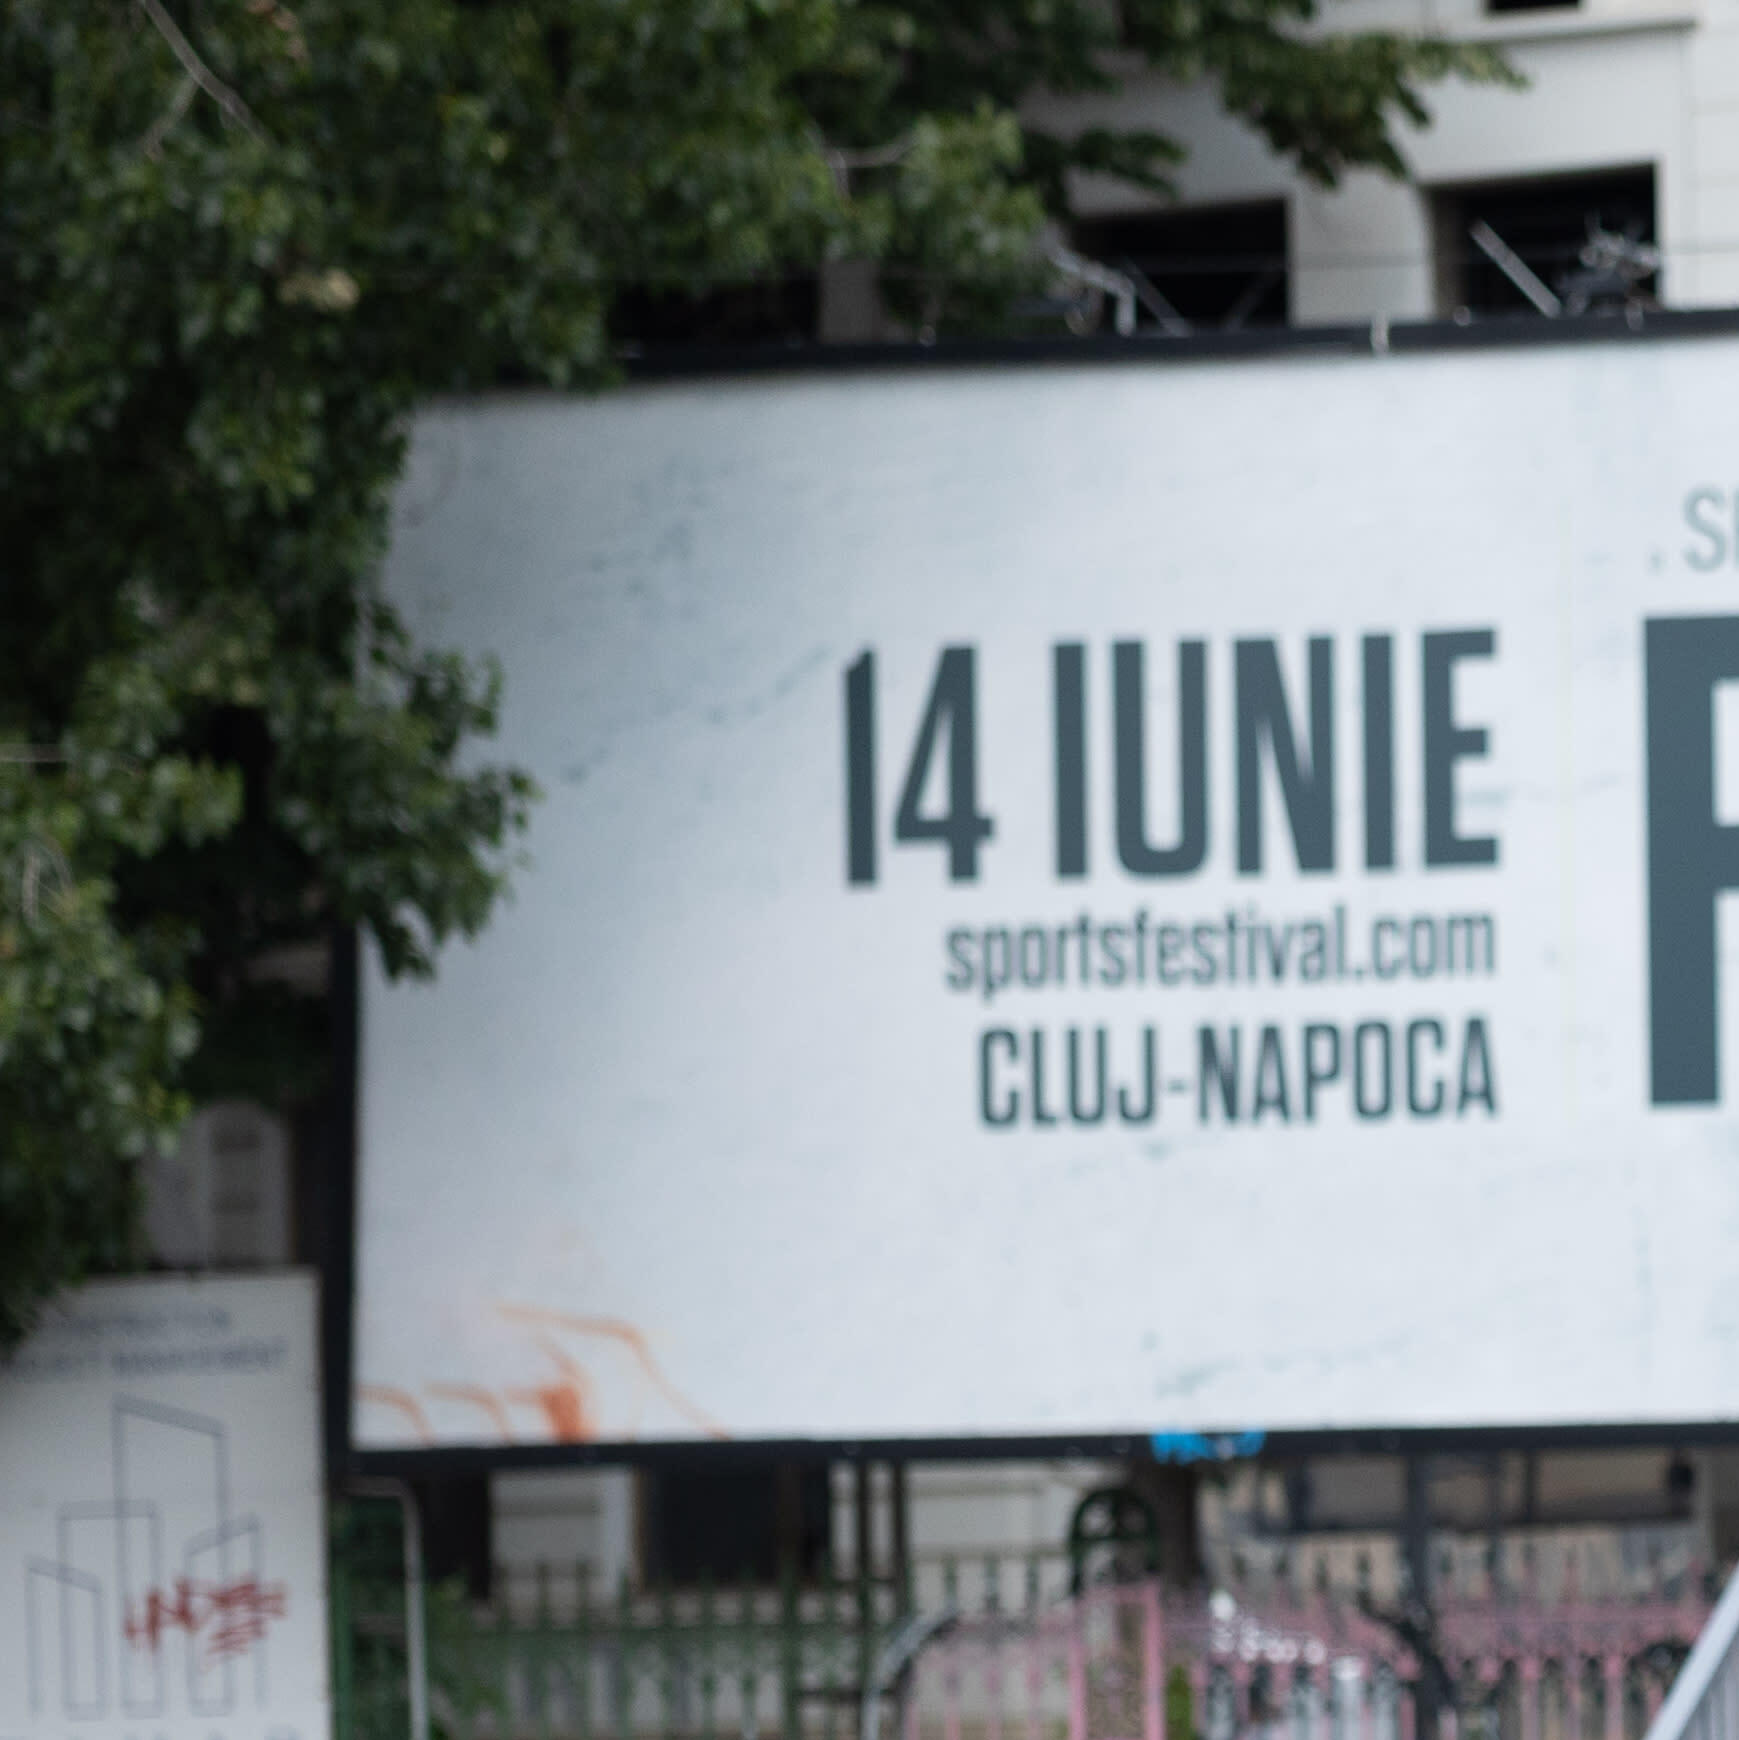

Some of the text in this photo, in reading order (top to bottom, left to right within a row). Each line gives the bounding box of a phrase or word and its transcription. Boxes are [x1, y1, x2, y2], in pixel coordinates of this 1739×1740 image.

[844, 627, 1499, 888] 14 IUNIE
[945, 901, 1497, 1003] sportsfestival.com
[979, 1015, 1498, 1129] CLUJ-NAPOCA
